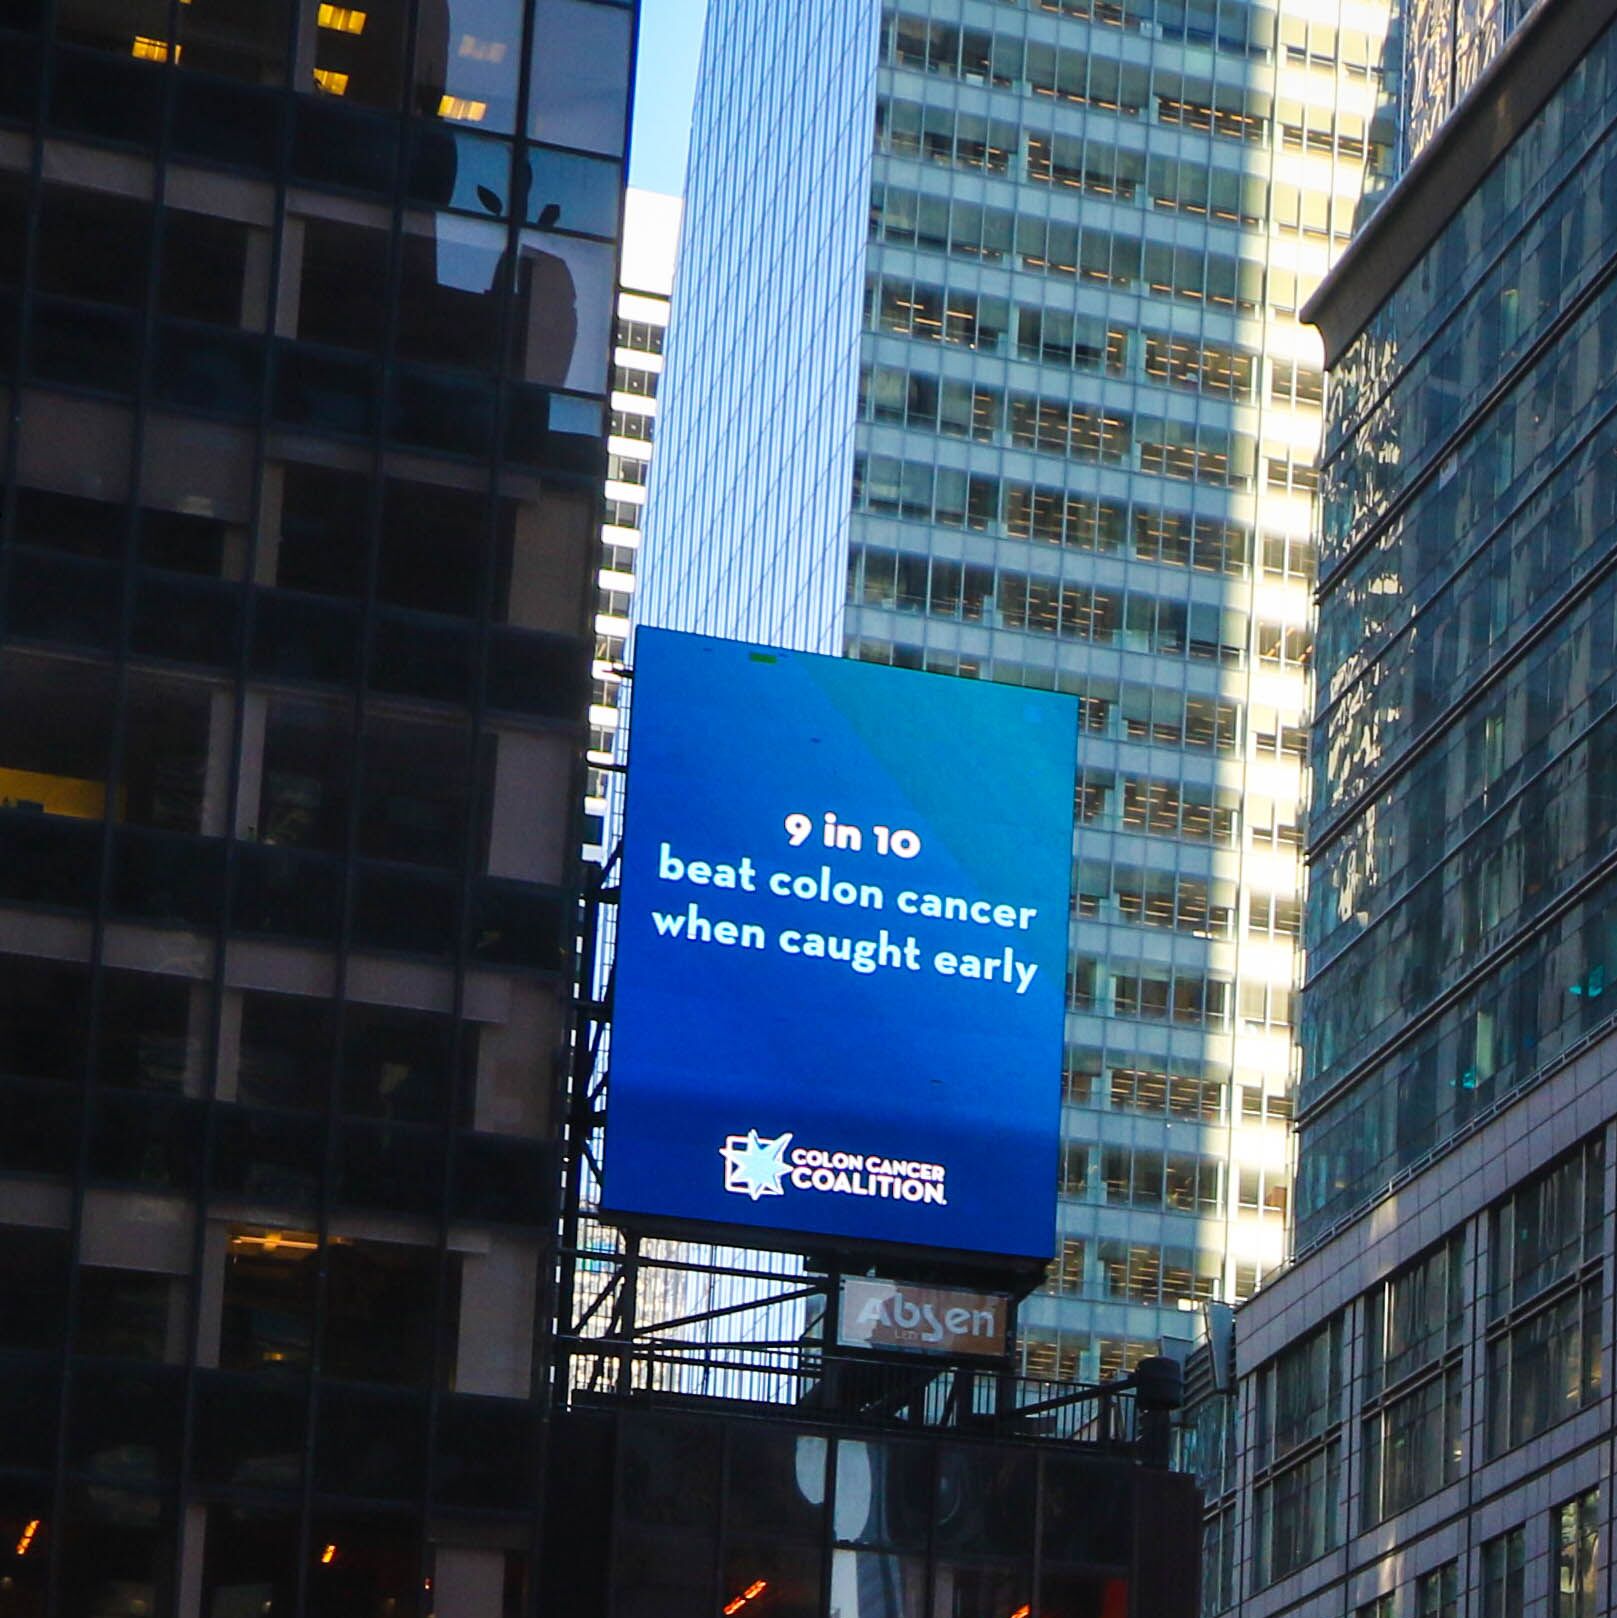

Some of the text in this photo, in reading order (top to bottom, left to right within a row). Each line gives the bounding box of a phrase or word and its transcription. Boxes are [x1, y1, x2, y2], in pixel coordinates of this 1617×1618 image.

[784, 812, 921, 859] 9 in 10
[659, 842, 1037, 929] beat colon cancer
[652, 903, 1038, 994] when caught early
[791, 1148, 945, 1182] COLON CANCER
[856, 1292, 996, 1342] Absen
